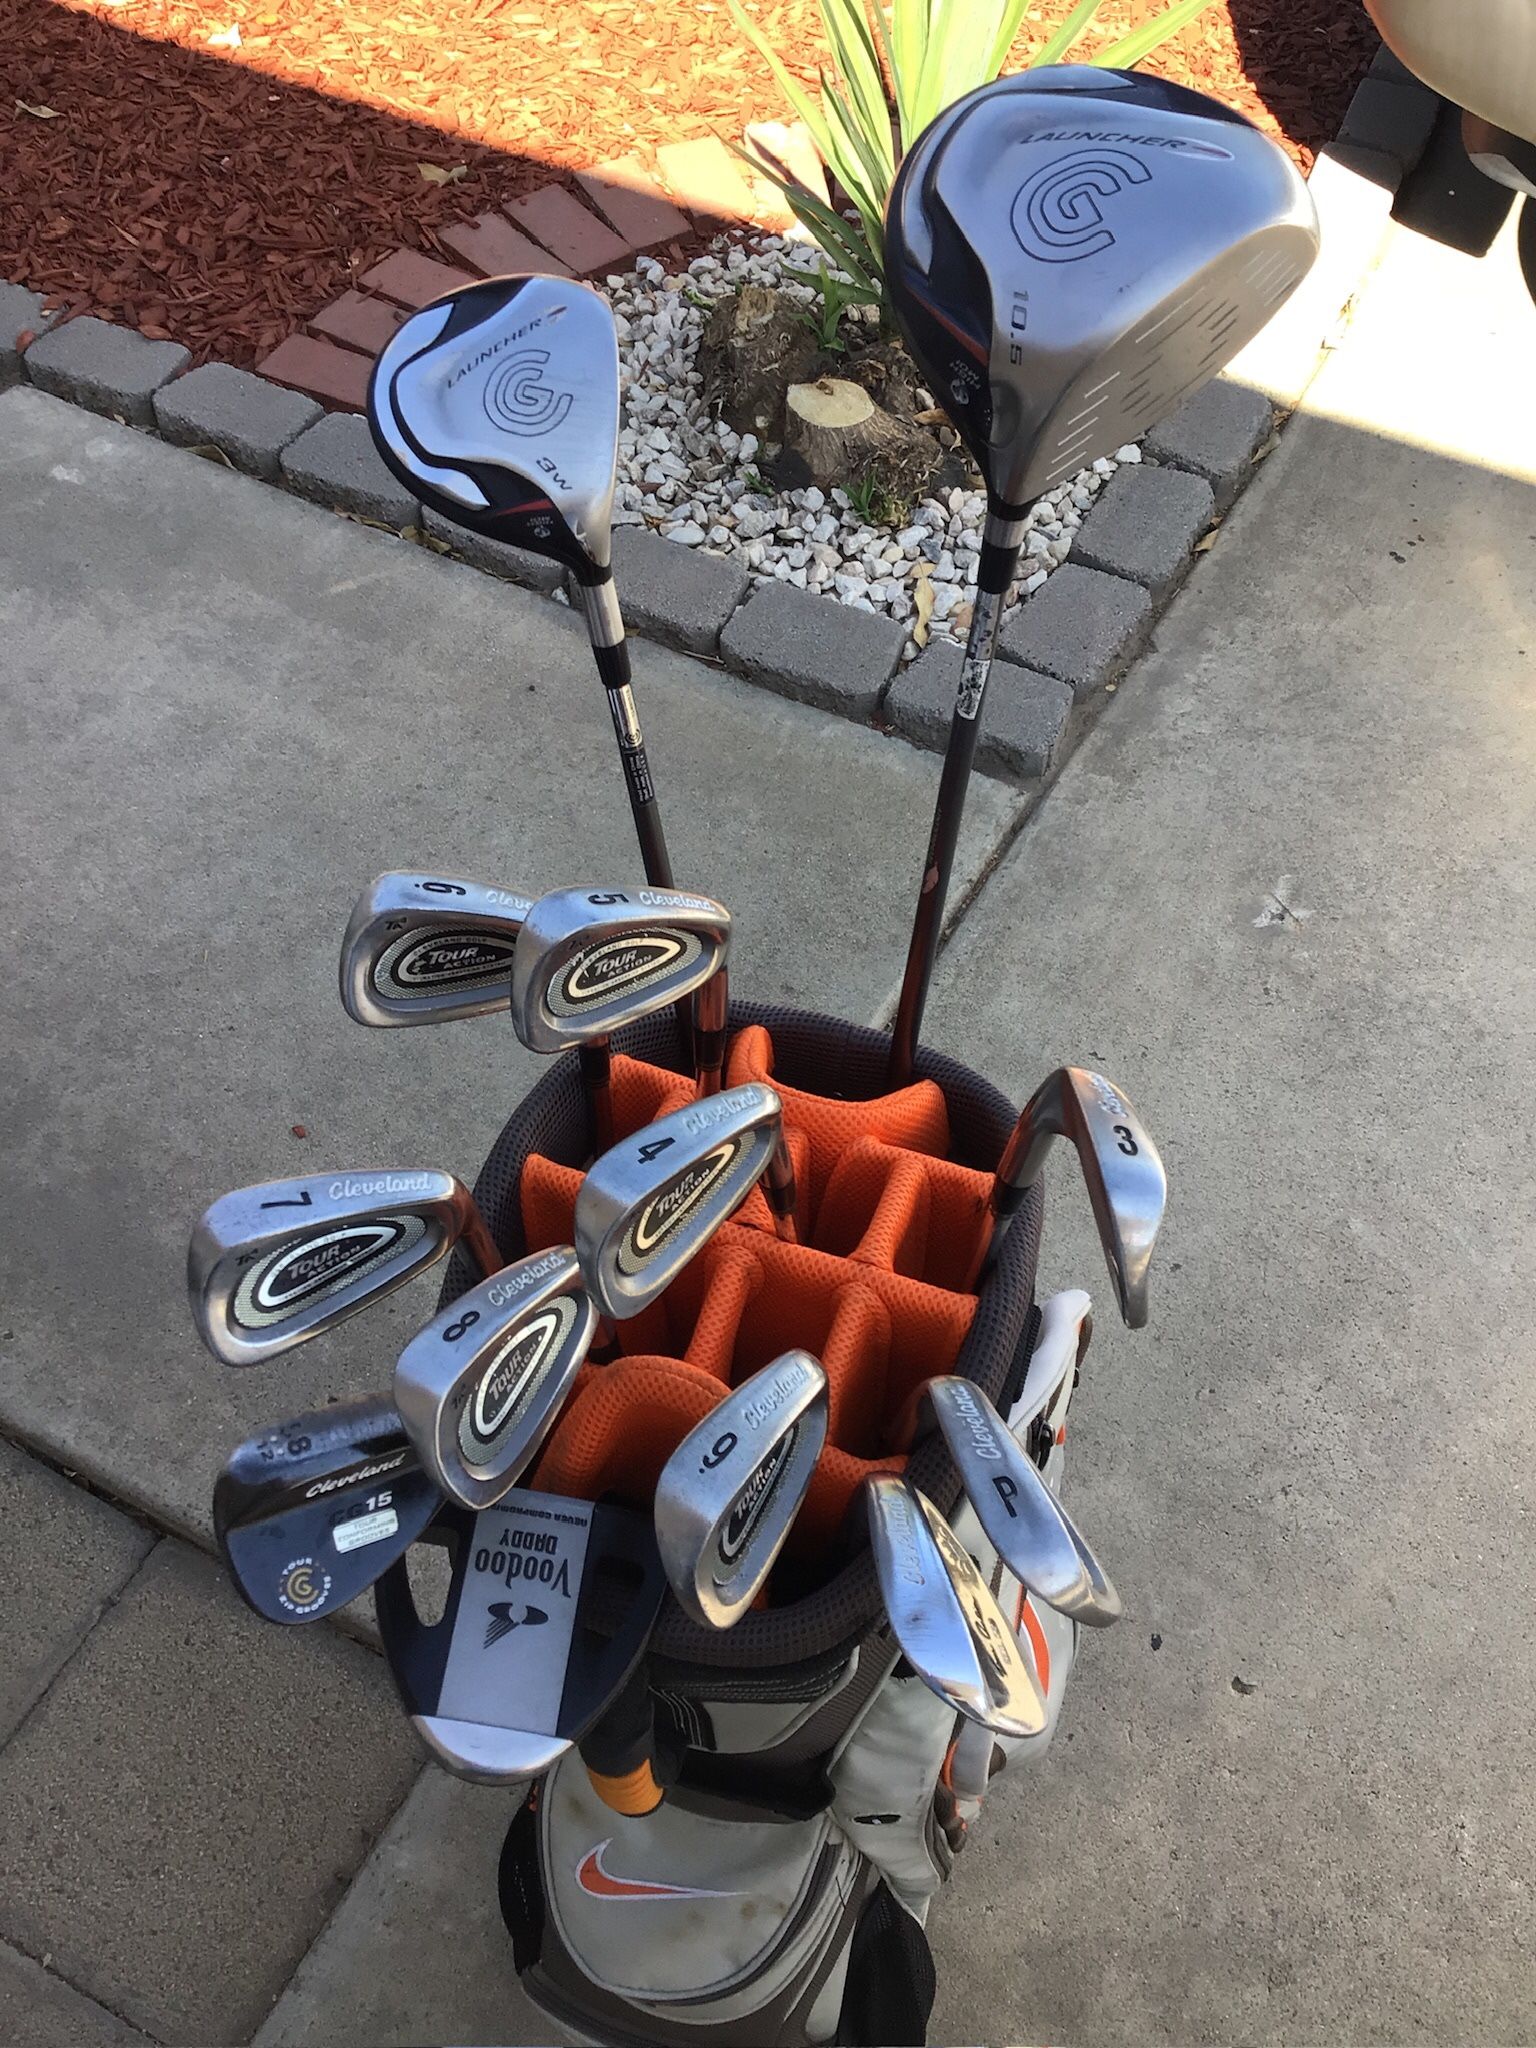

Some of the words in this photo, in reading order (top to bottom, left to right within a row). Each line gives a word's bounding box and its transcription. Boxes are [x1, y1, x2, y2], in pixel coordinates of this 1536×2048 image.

[1020, 131, 1187, 151] LAUNCHER
[1010, 290, 1029, 367] 10.5
[447, 318, 543, 389] LAUNCHER
[588, 892, 629, 905] 5
[639, 890, 716, 912] Cleveland
[427, 946, 479, 966] TOUR
[443, 954, 496, 971] ACTION
[595, 949, 636, 975] TOUR
[607, 953, 653, 978] ACTION
[682, 1087, 759, 1134] Cleveland
[638, 1137, 675, 1164] 4
[1113, 1125, 1139, 1156] 3
[261, 1191, 312, 1209] 7
[328, 1172, 431, 1201] Cleveland
[656, 1172, 695, 1218] TOUR
[671, 1168, 711, 1212] ACTION
[287, 1245, 340, 1279] TOUR
[307, 1246, 361, 1279] ACTION
[488, 1254, 566, 1307] Cleveland
[442, 1311, 480, 1342] 8
[489, 1350, 522, 1401] TOUR
[506, 1343, 537, 1393] ACTION
[744, 1361, 809, 1431] Cleveland
[949, 1383, 1002, 1461] Cleveland
[306, 1453, 405, 1498] Cleveland
[749, 1457, 776, 1512] ACTION
[734, 1468, 764, 1520] TOUR
[992, 1475, 1017, 1518] P
[500, 1528, 559, 1555] DADDY
[282, 1558, 312, 1575] TOUR
[475, 1549, 571, 1598] Voodoo
